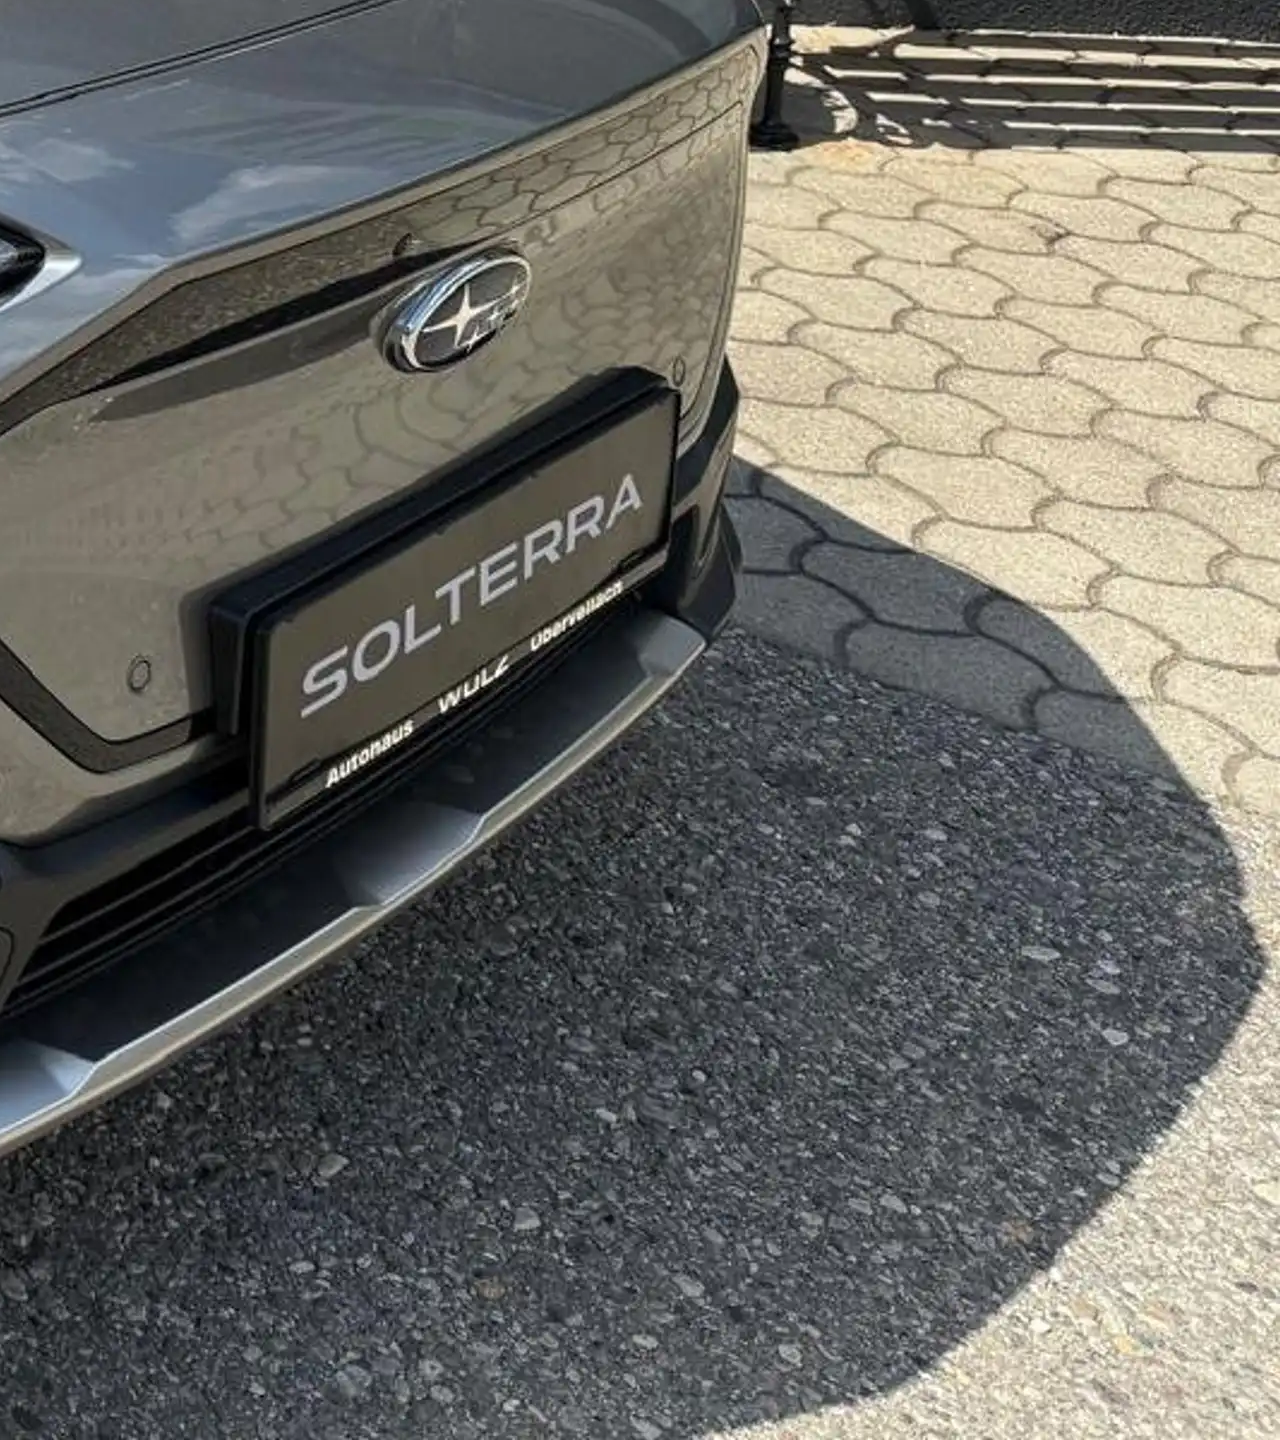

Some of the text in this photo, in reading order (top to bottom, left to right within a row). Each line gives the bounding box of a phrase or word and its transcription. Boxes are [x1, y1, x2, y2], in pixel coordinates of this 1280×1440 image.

[300, 472, 644, 719] SOLTERRA
[325, 719, 415, 789] Autohaus
[437, 654, 511, 714] WULZ
